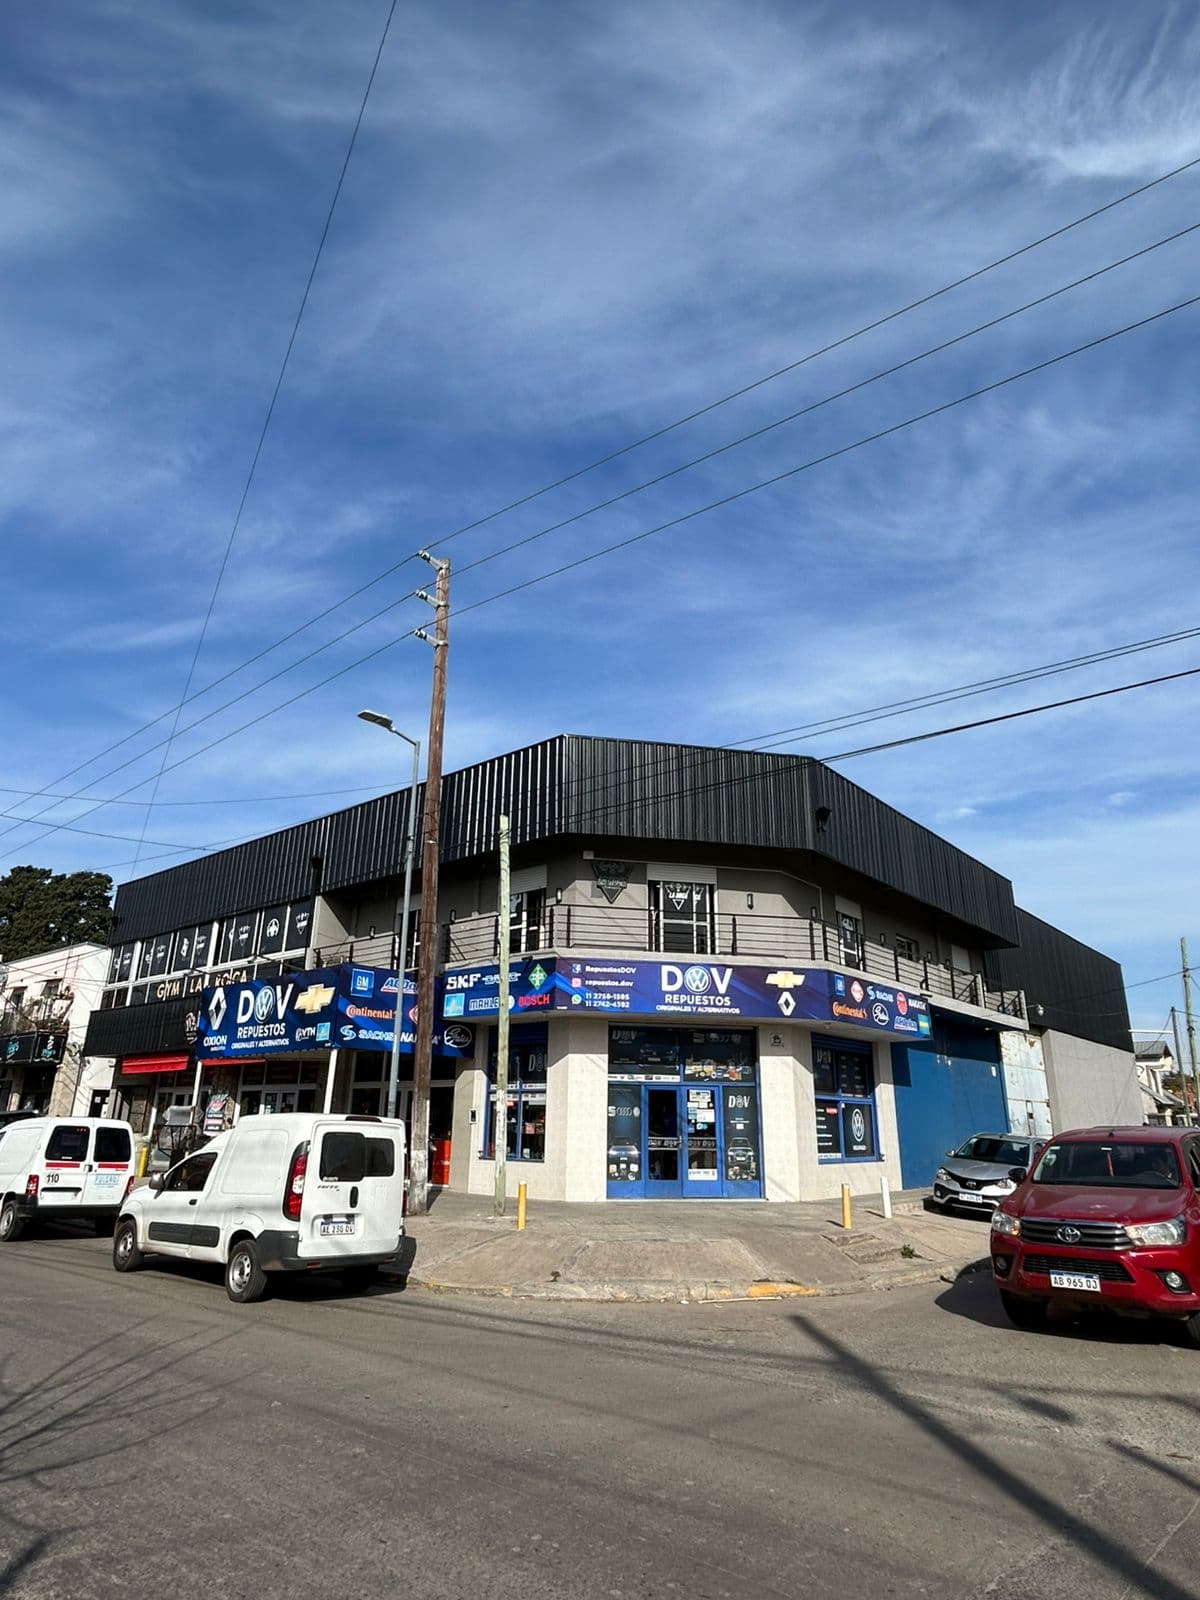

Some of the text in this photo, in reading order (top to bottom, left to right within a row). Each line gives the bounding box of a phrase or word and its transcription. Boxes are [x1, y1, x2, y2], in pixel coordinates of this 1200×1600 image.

[446, 973, 481, 990] SKF
[156, 982, 180, 1000] GYM
[469, 997, 500, 1010] MAHLE
[518, 994, 550, 1007] BOSCH
[665, 993, 731, 1007] REPUESTOS
[346, 1004, 393, 1019] Continental
[656, 1004, 691, 1012] ORIGINALES
[697, 1006, 741, 1015] ALTERNATIVOS
[237, 1022, 286, 1039] REPUESTOS
[203, 1035, 228, 1048] OXION
[46, 1173, 60, 1184] 110
[1054, 1276, 1064, 1286] AB
[1066, 1277, 1083, 1288] 965
